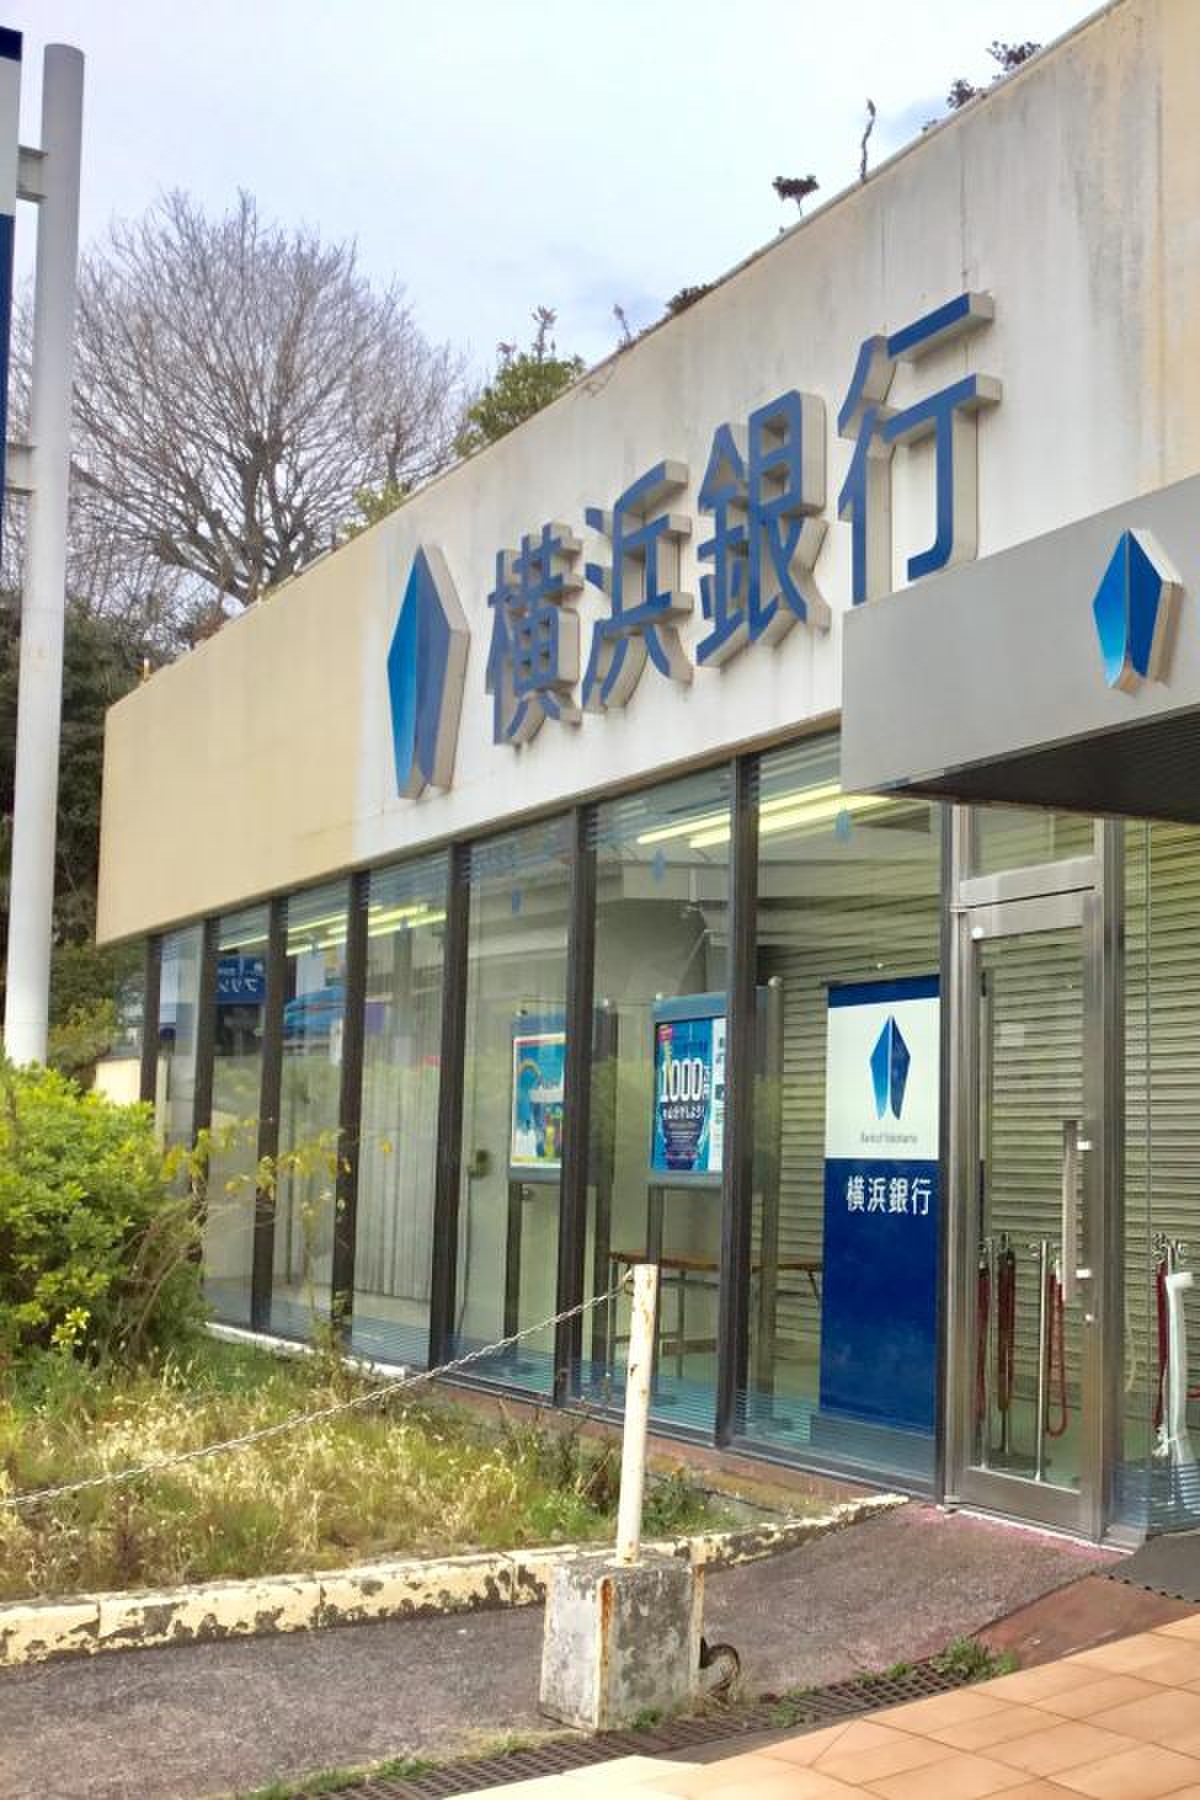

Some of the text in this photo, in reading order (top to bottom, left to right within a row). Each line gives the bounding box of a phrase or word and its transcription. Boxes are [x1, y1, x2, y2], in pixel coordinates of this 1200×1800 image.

[485, 292, 1000, 746] 横浜銀行
[847, 1175, 931, 1216] 横浜銀行
